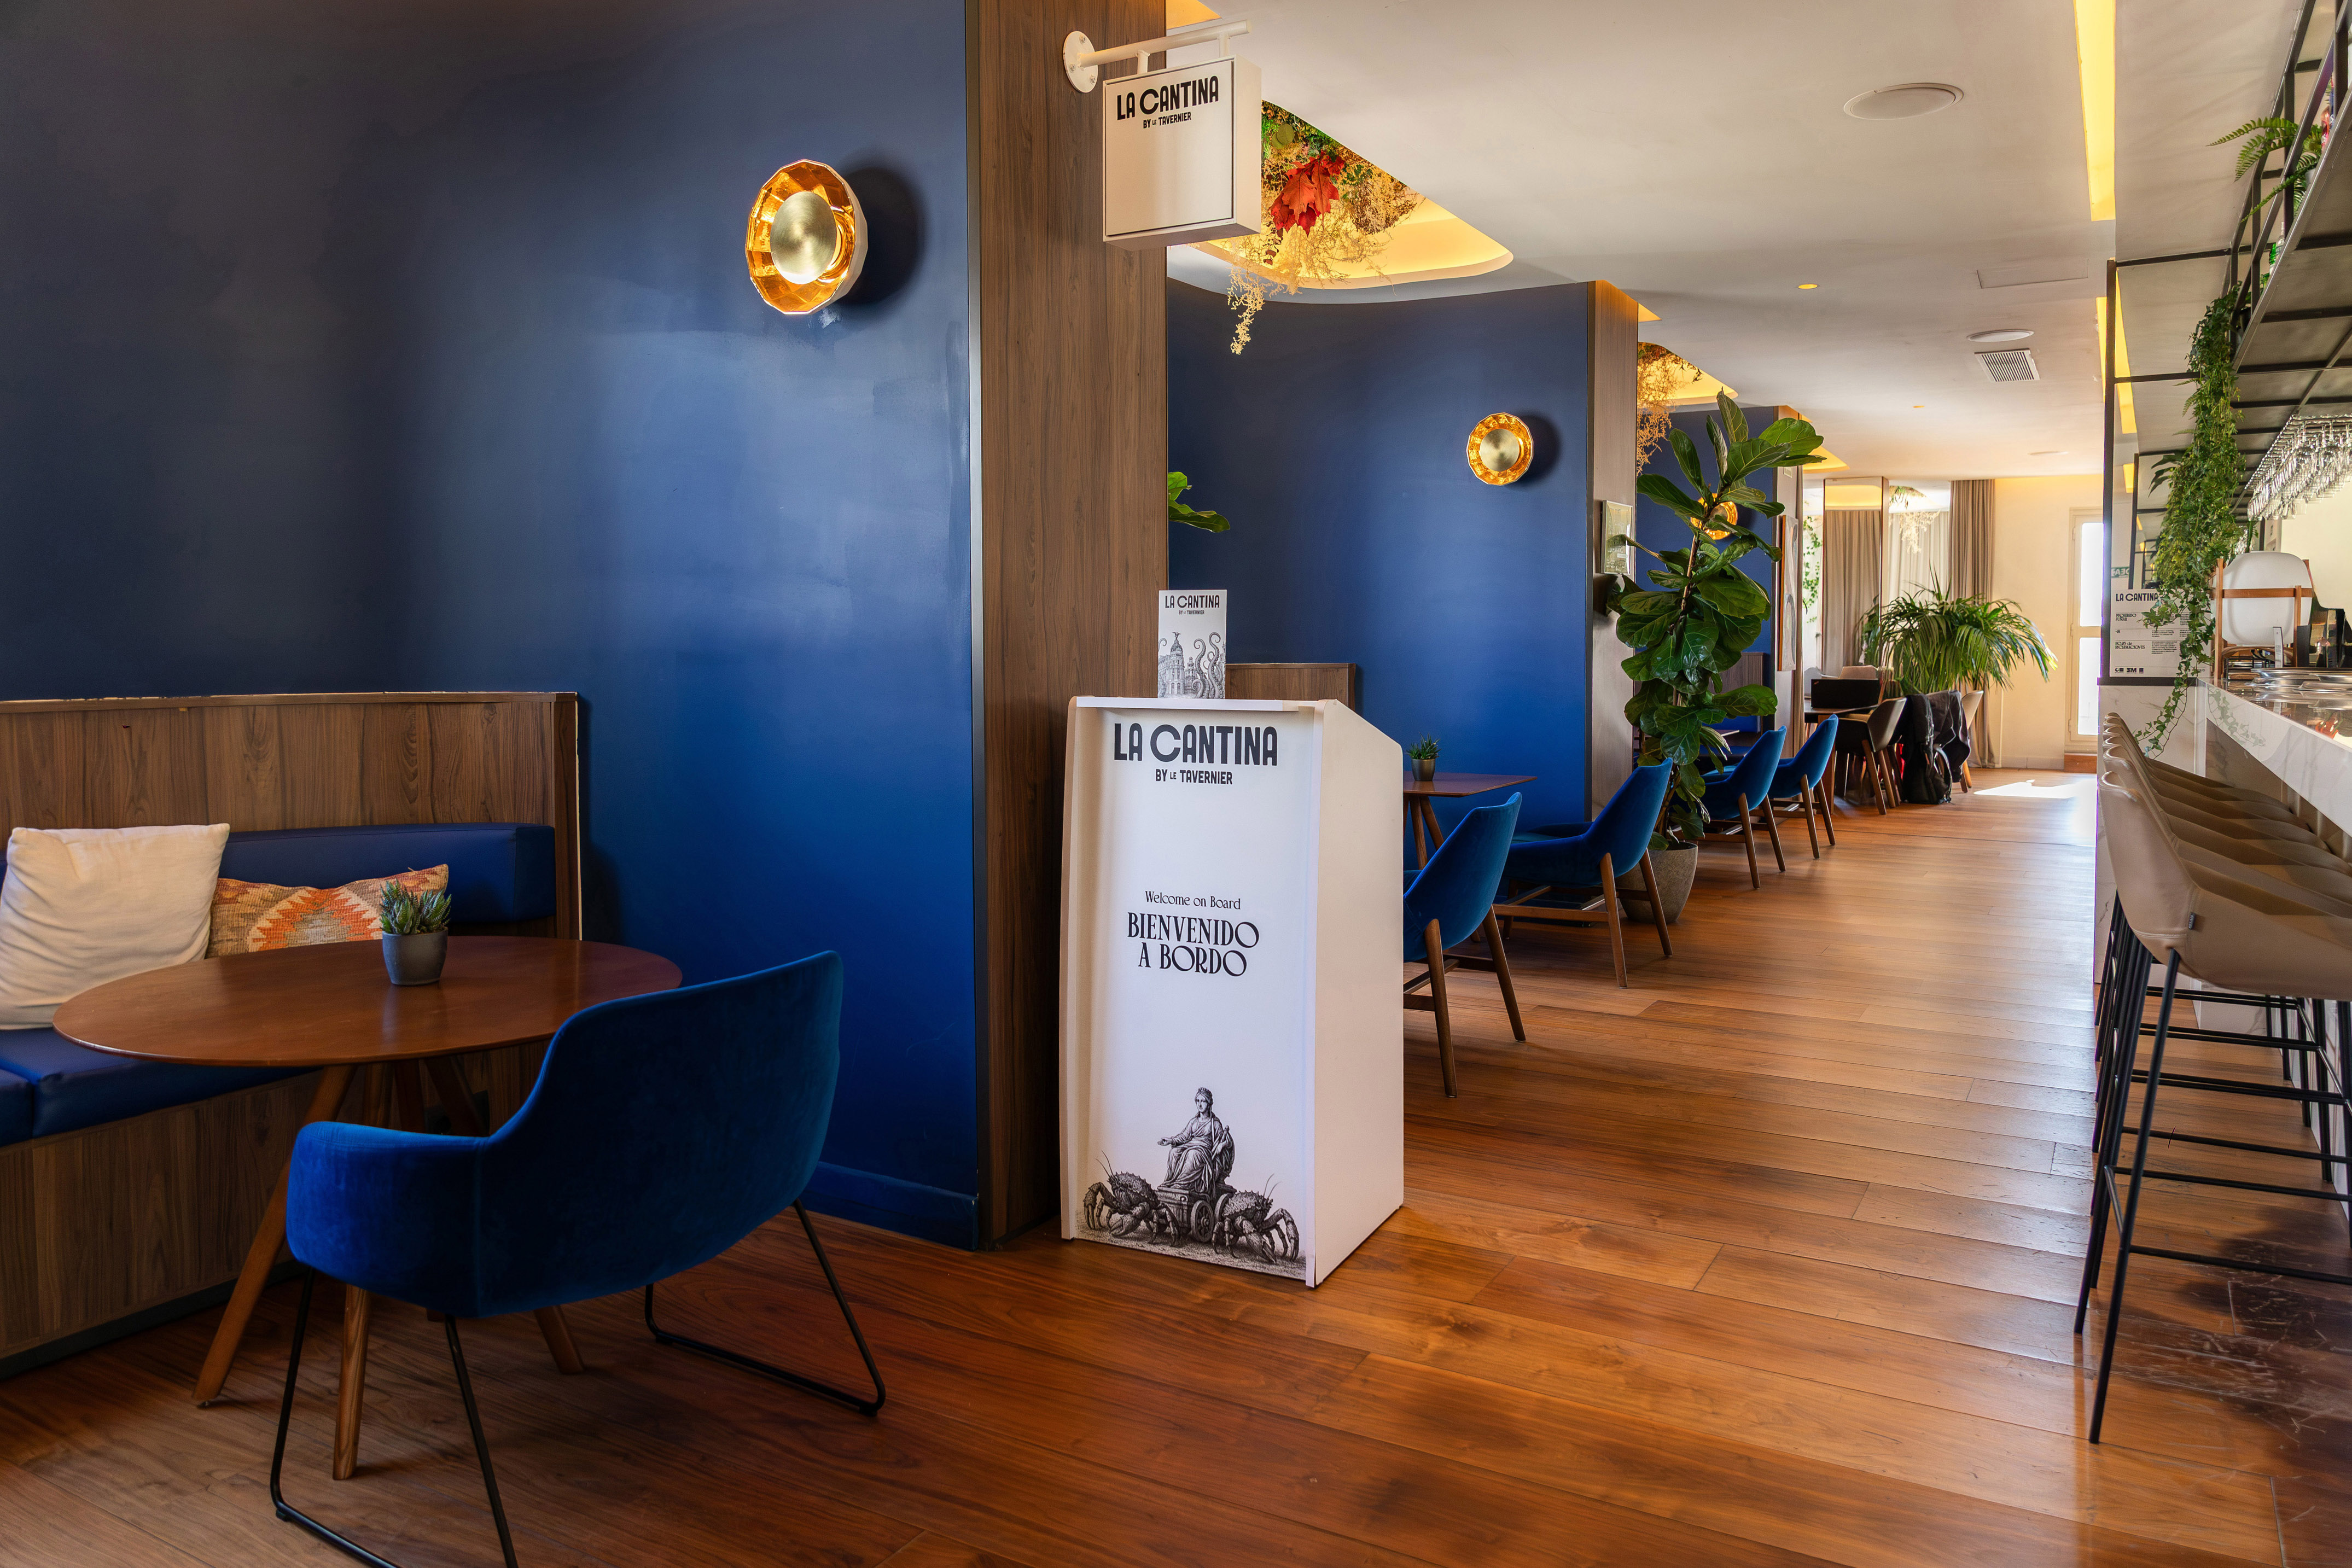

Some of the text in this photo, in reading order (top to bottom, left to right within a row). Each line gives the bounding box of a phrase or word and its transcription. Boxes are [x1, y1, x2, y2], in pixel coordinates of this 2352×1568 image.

[1117, 75, 1219, 120] LA CANTINA
[1143, 119, 1151, 129] BY
[1158, 112, 1191, 126] TAVERNIER
[1165, 594, 1220, 608] LA CANTINA
[2126, 593, 2158, 601] CANTINA
[1114, 723, 1277, 766] LA CANTINA
[1155, 769, 1233, 785] BY LE TAVERNIER
[1145, 891, 1241, 910] Welcome on Board
[1127, 912, 1259, 949] BIENVENIDO
[1138, 942, 1247, 977] A BORDO
